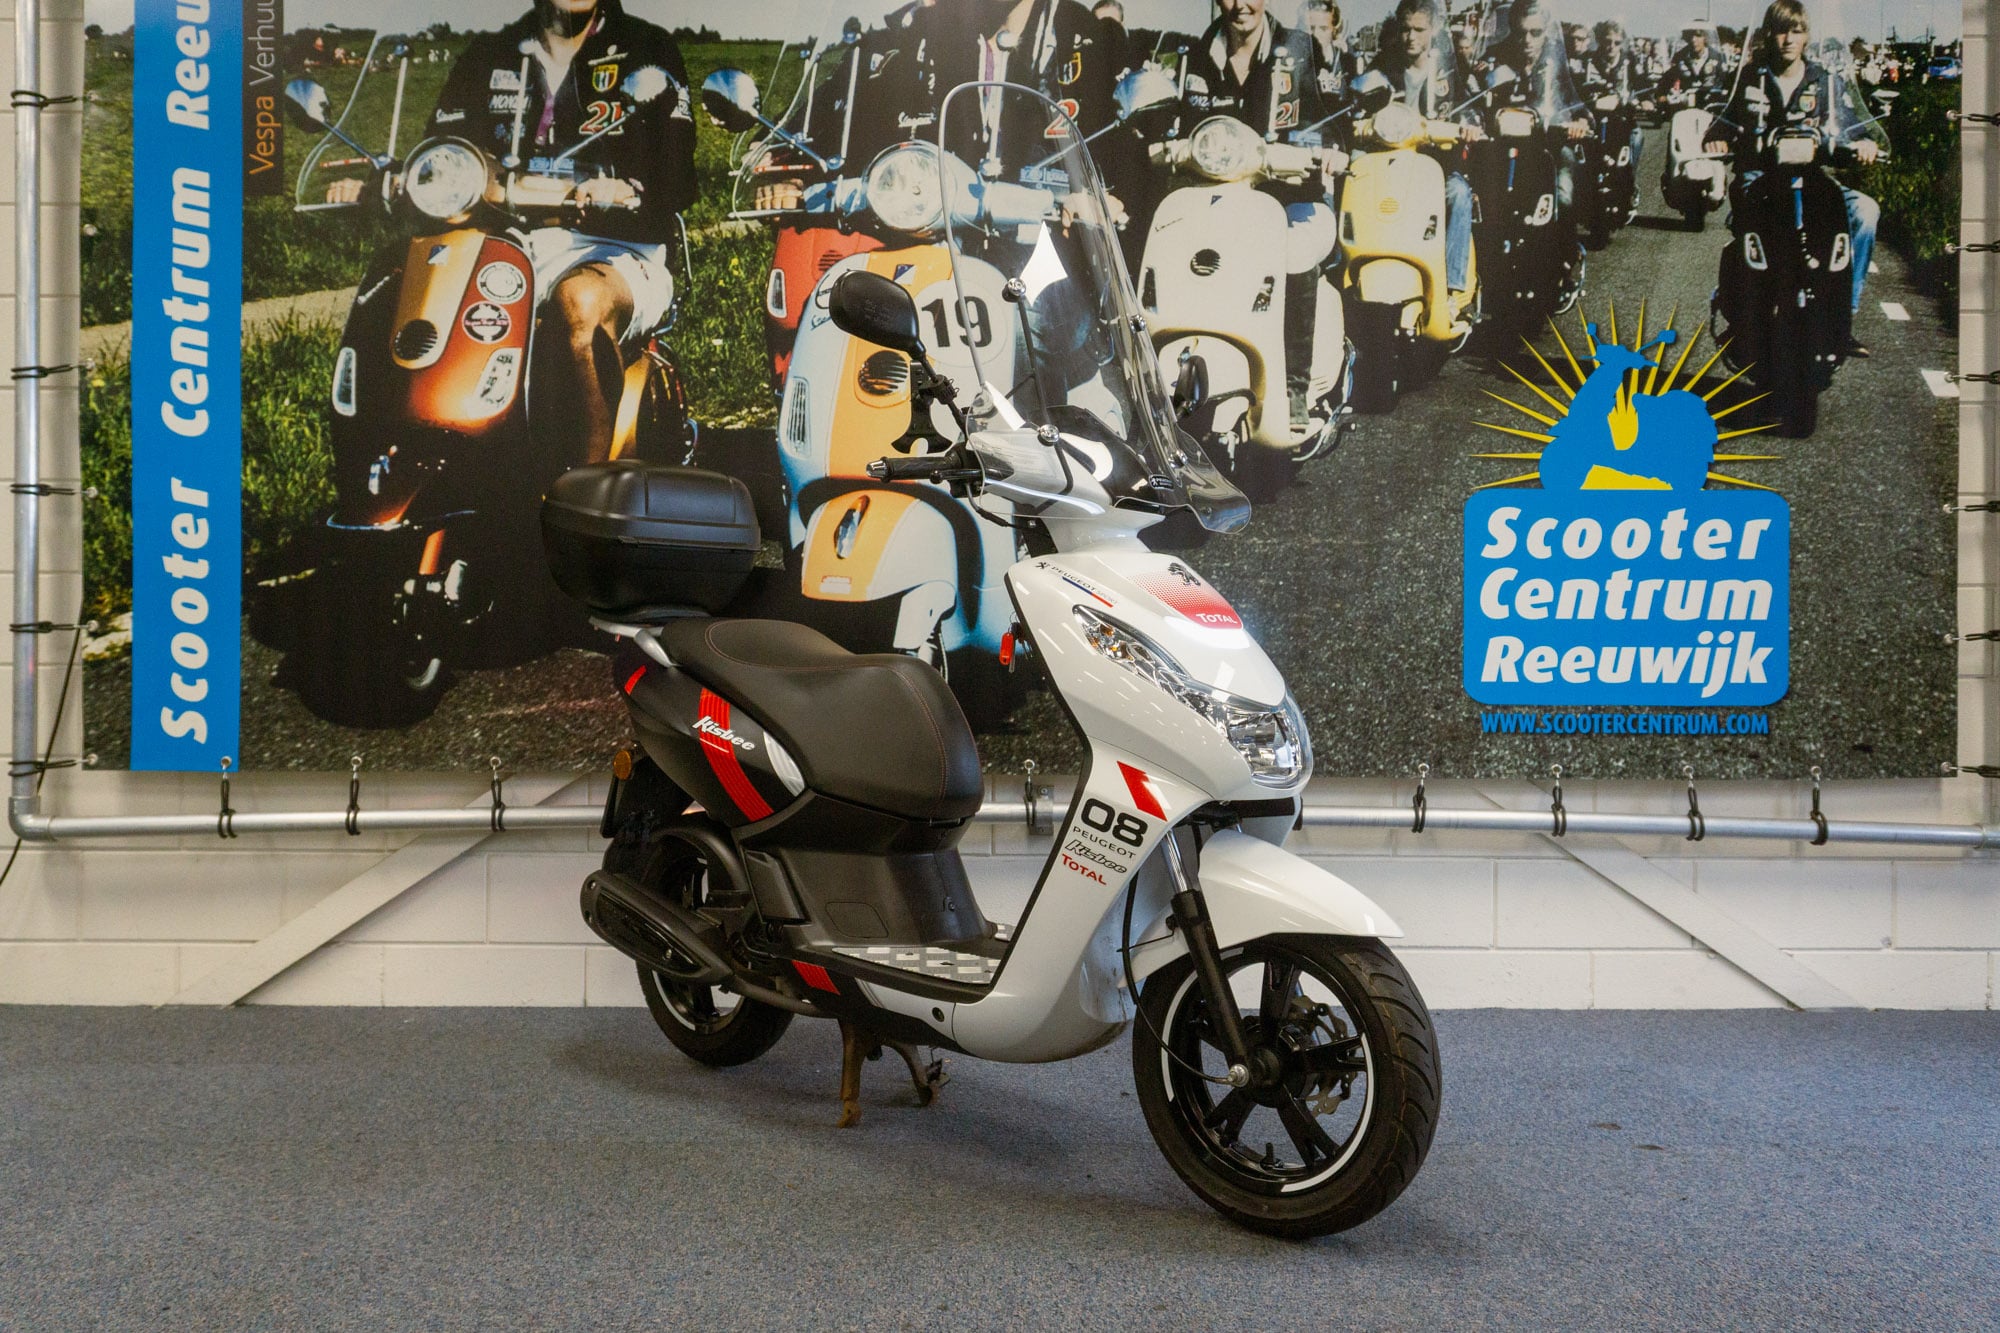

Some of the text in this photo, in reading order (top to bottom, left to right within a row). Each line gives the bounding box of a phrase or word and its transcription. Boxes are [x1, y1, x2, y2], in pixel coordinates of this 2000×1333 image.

[249, 96, 281, 174] Vespa
[161, 167, 210, 437] Centrum
[921, 296, 993, 349] 19
[1480, 506, 1772, 560] Scooter
[160, 477, 210, 744] Scooter
[1195, 612, 1238, 625] TOTAL
[1479, 567, 1773, 621] Centrum
[1480, 630, 1774, 699] Reeuwijk
[692, 715, 756, 751] Kisbee
[1480, 712, 1769, 736] WWW.SCOOTERCENTRUM.COM
[1072, 825, 1137, 859] PEUGEOT
[1080, 797, 1149, 848] 08
[1061, 853, 1108, 886] TOTAL
[1064, 839, 1128, 874] Kisbee
